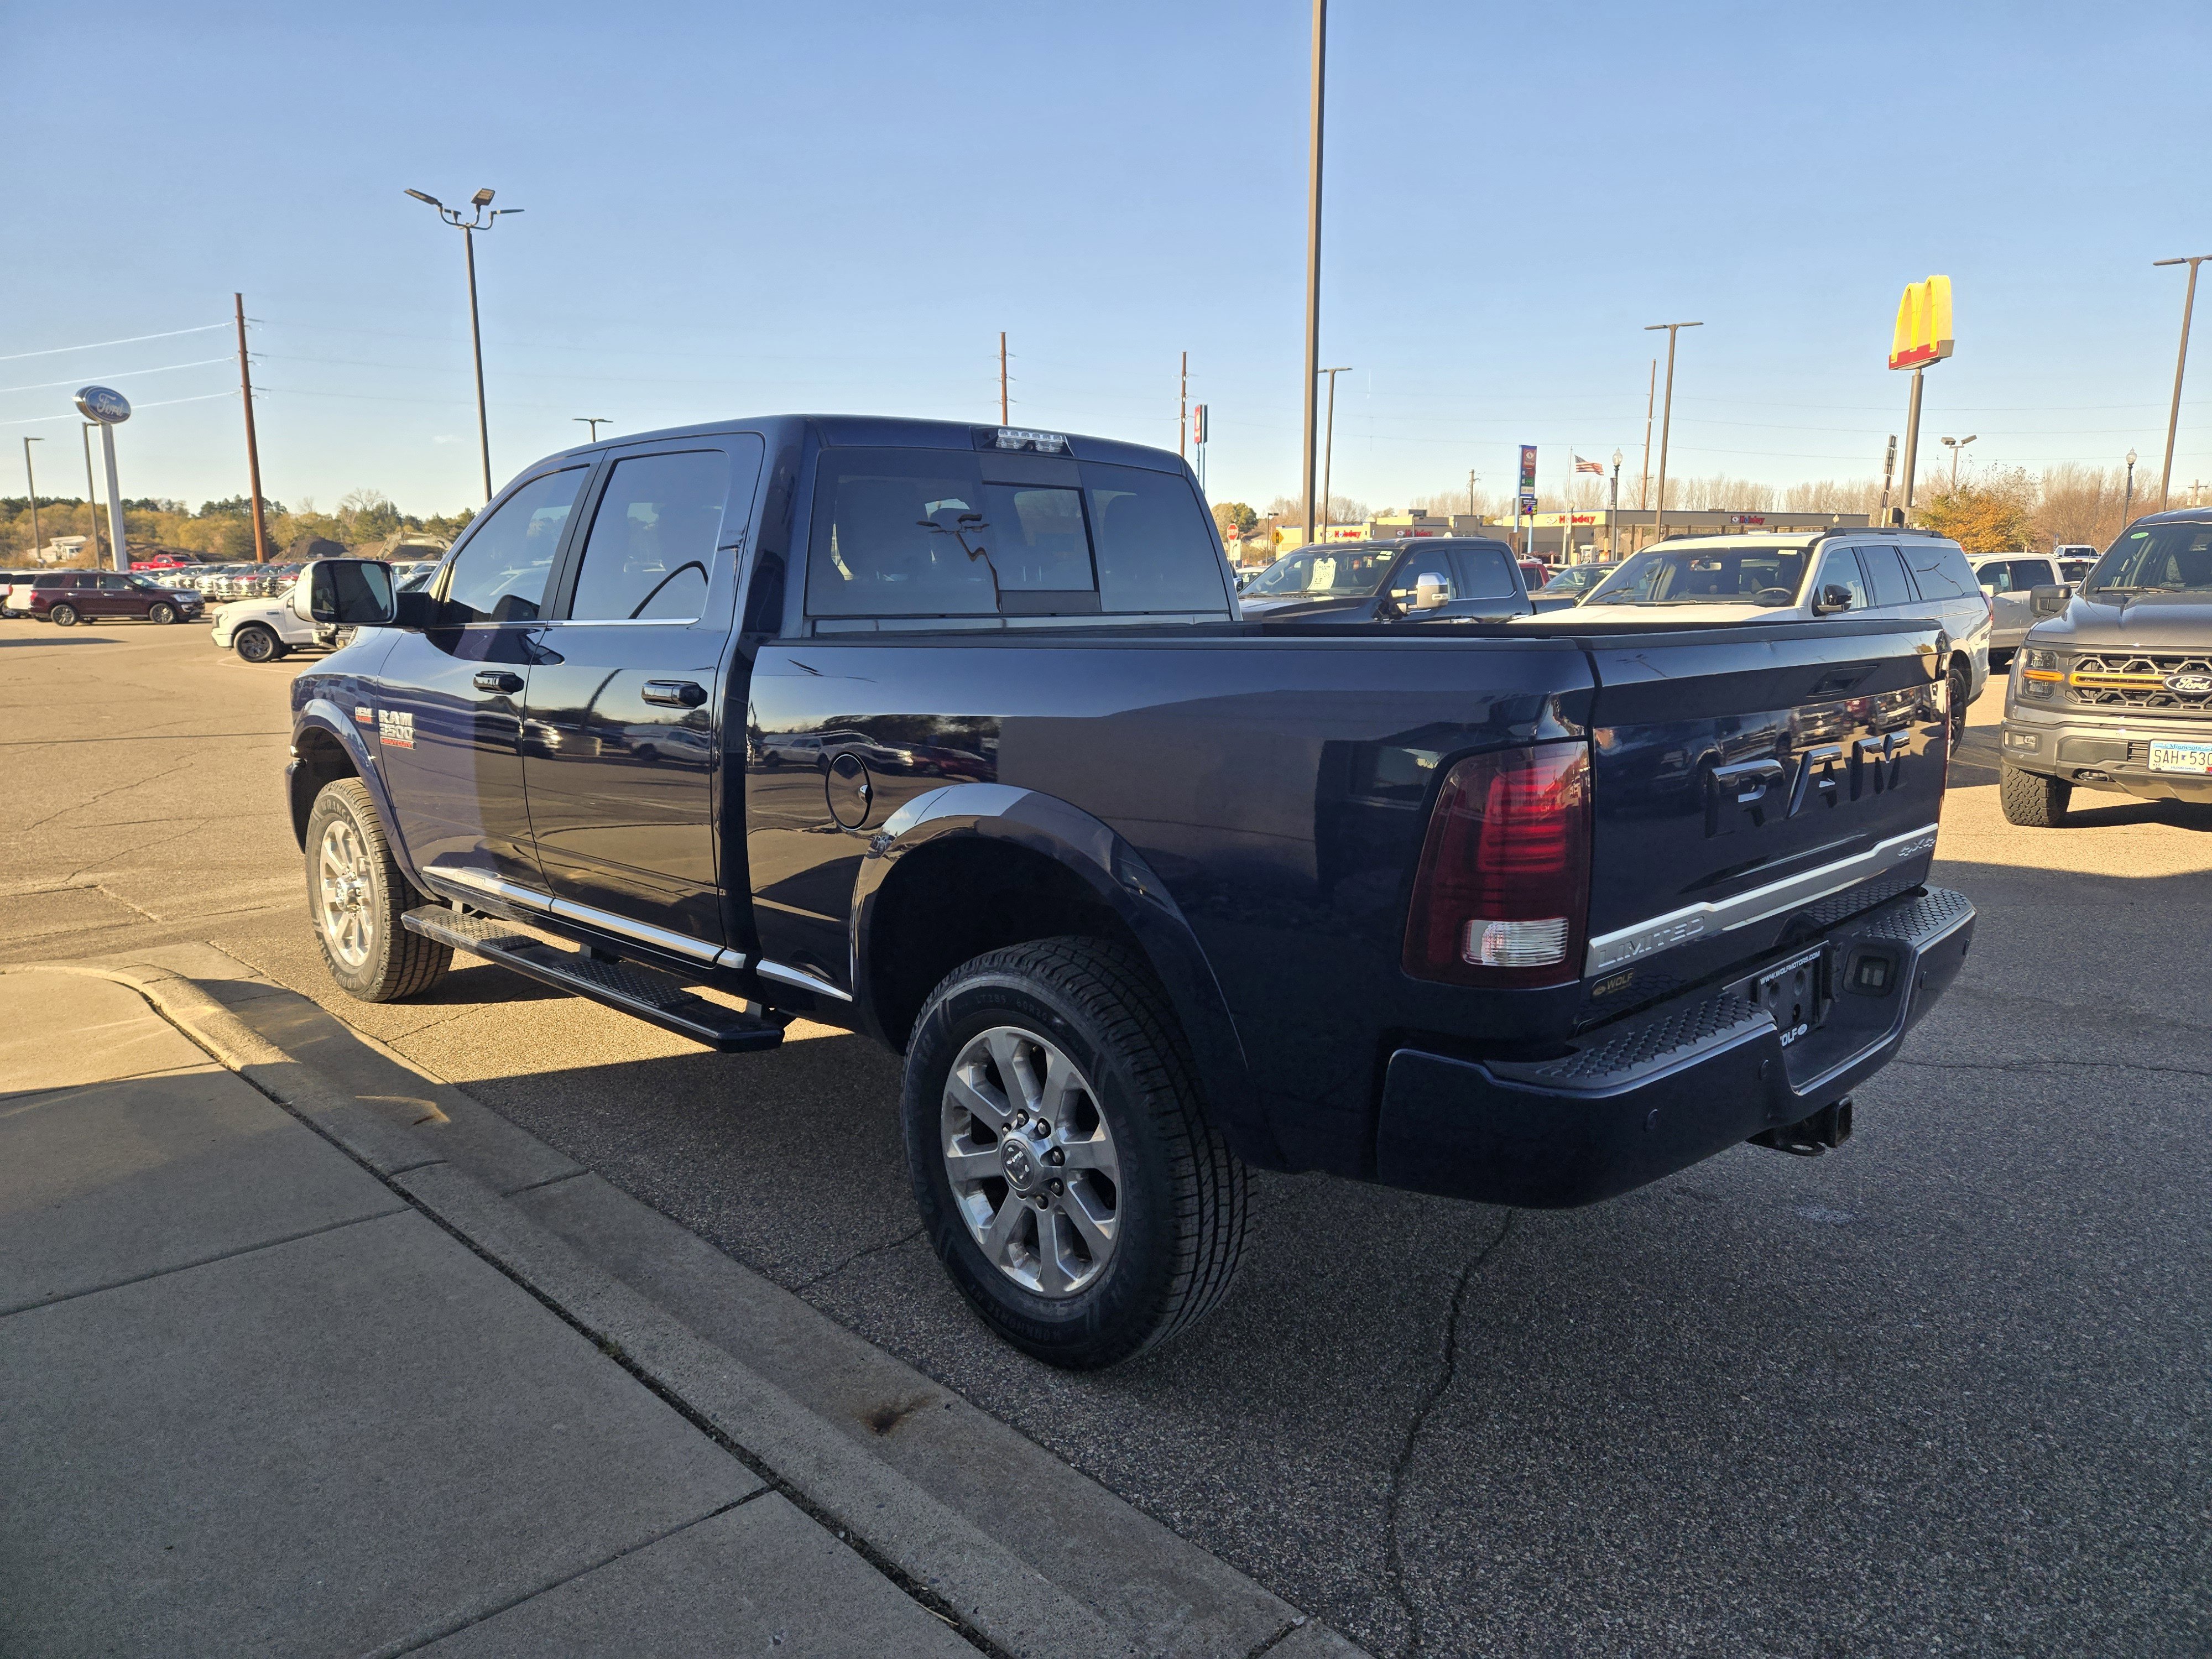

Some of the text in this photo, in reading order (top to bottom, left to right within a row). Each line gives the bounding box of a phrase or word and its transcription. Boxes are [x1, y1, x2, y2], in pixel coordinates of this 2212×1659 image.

[96, 393, 124, 417] Ford
[2176, 677, 2211, 690] Ford
[378, 709, 413, 726] RAM
[379, 723, 414, 740] 3500
[2154, 749, 2179, 764] SAH
[1706, 731, 1910, 838] RAM
[1598, 916, 1705, 968] LIMITED
[1760, 951, 1821, 985] WWW.WOLFMOTORS.COM
[1606, 972, 1634, 989] WOLF
[1780, 1027, 1798, 1047] OLF
